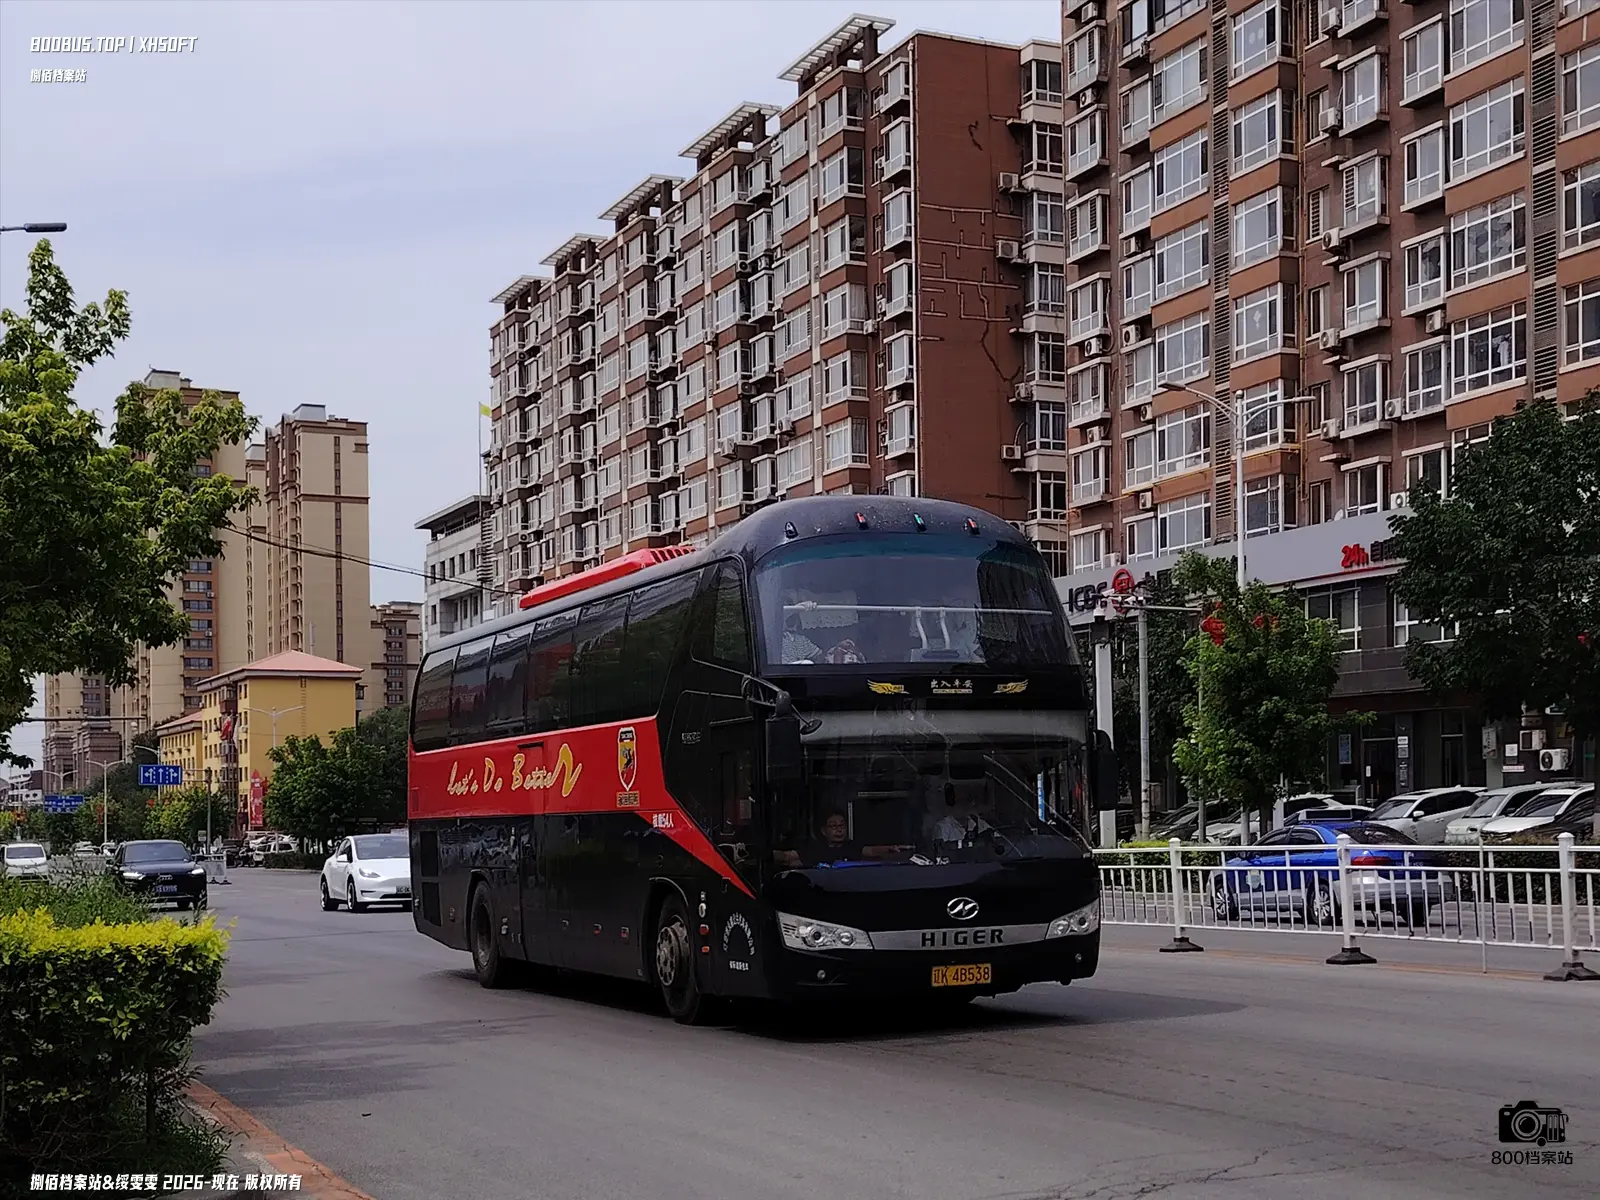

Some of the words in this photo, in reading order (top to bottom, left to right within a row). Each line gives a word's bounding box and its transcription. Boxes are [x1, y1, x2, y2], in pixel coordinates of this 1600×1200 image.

[1341, 543, 1369, 568] 24h
[483, 757, 503, 793] Do
[921, 929, 1004, 947] HIGER
